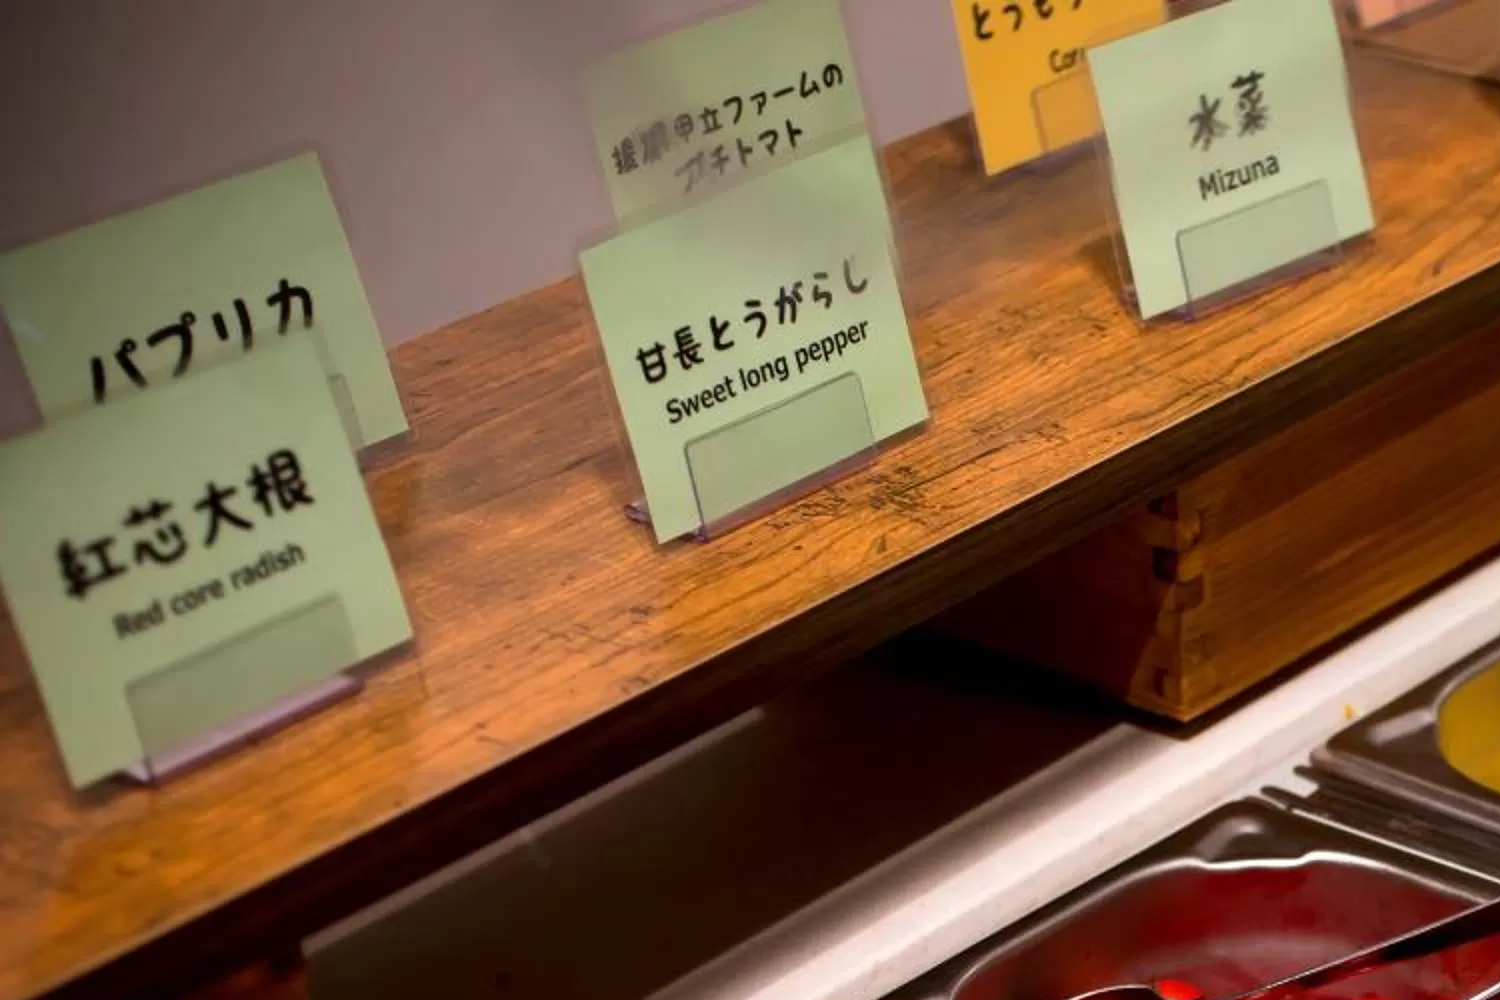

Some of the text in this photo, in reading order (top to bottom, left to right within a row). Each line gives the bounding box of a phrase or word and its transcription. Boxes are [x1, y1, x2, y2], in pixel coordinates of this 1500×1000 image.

[972, 0, 1081, 41] とう
[674, 118, 803, 194] プチトマト
[1188, 70, 1269, 152] 水菜
[1197, 154, 1281, 201] Mizuna
[90, 278, 313, 406] パプリカ
[636, 257, 868, 385] 甘長とうがらし
[665, 320, 869, 425] Sweet long pepper
[57, 448, 316, 603] 紅芯大根
[112, 541, 306, 640] Red core radish
